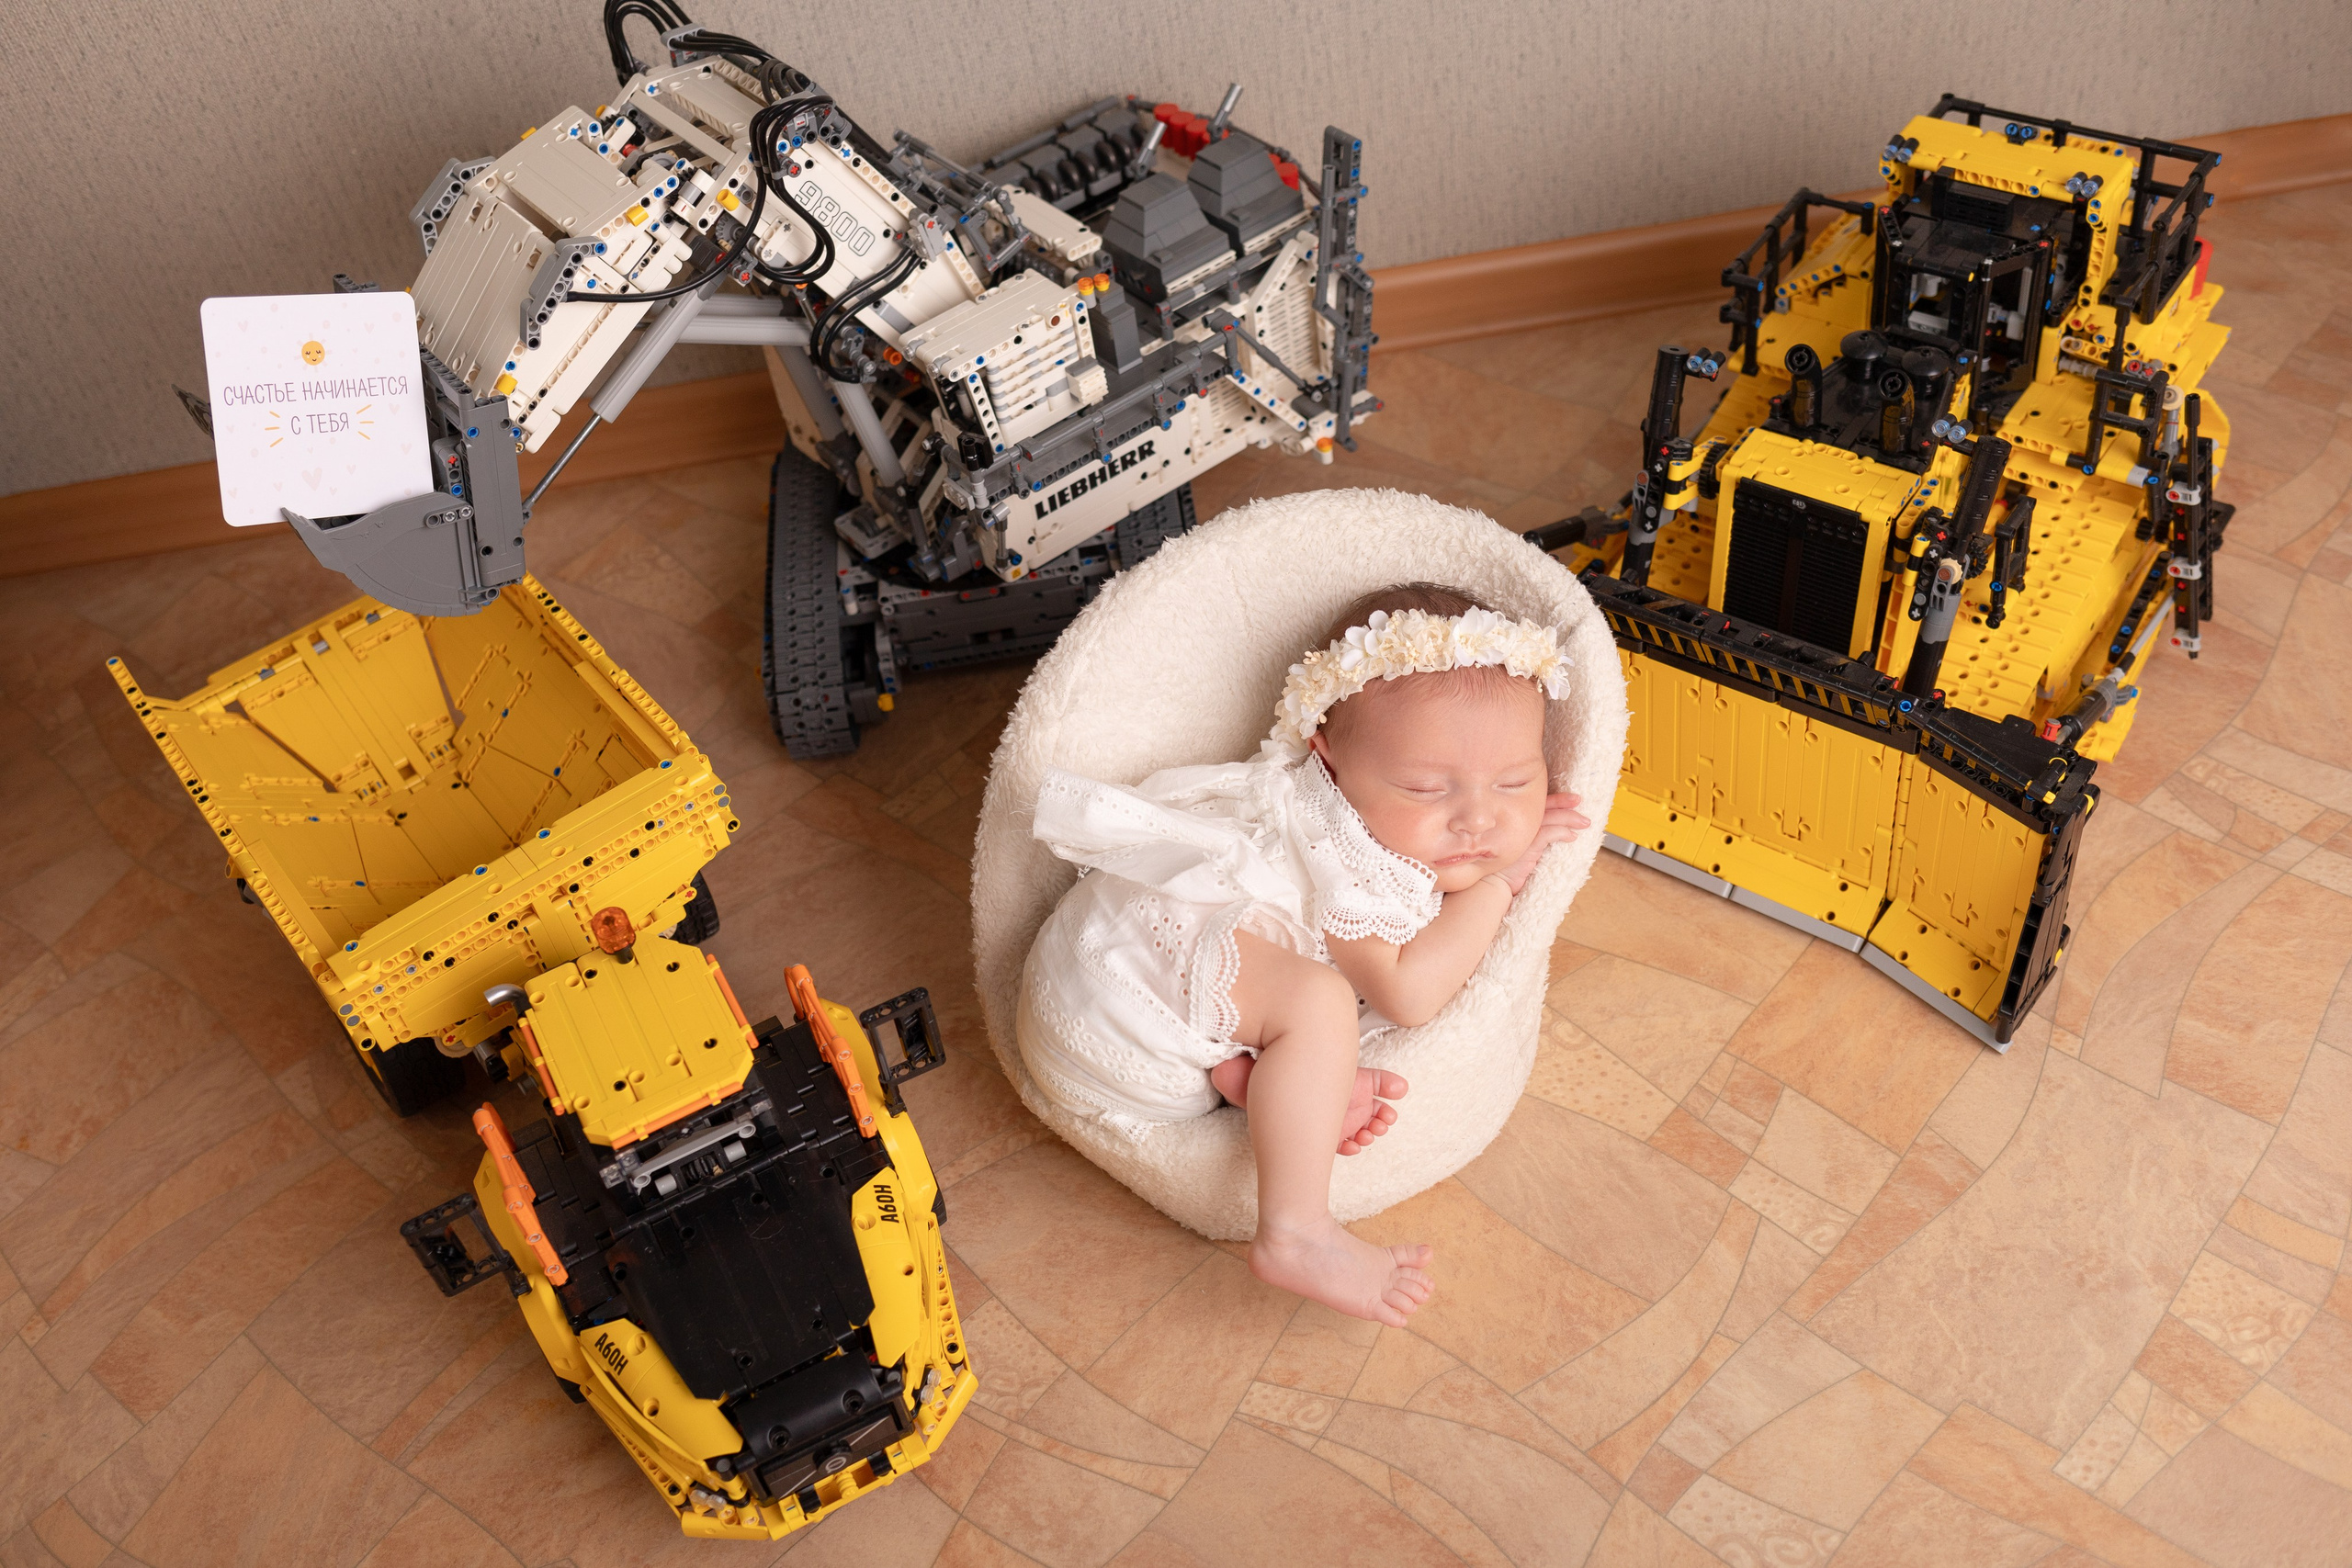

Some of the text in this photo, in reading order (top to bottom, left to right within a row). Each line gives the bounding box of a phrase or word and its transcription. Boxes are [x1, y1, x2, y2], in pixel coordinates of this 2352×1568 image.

[795, 180, 876, 256] 9800
[223, 376, 408, 406] СЧАСТЬЕ НАЧИНАЕТСЯ
[290, 412, 350, 435] С ТЕБЯ
[1035, 440, 1156, 520] LIEBHERR
[874, 1184, 899, 1224] A60H
[594, 1332, 628, 1376] A60H
